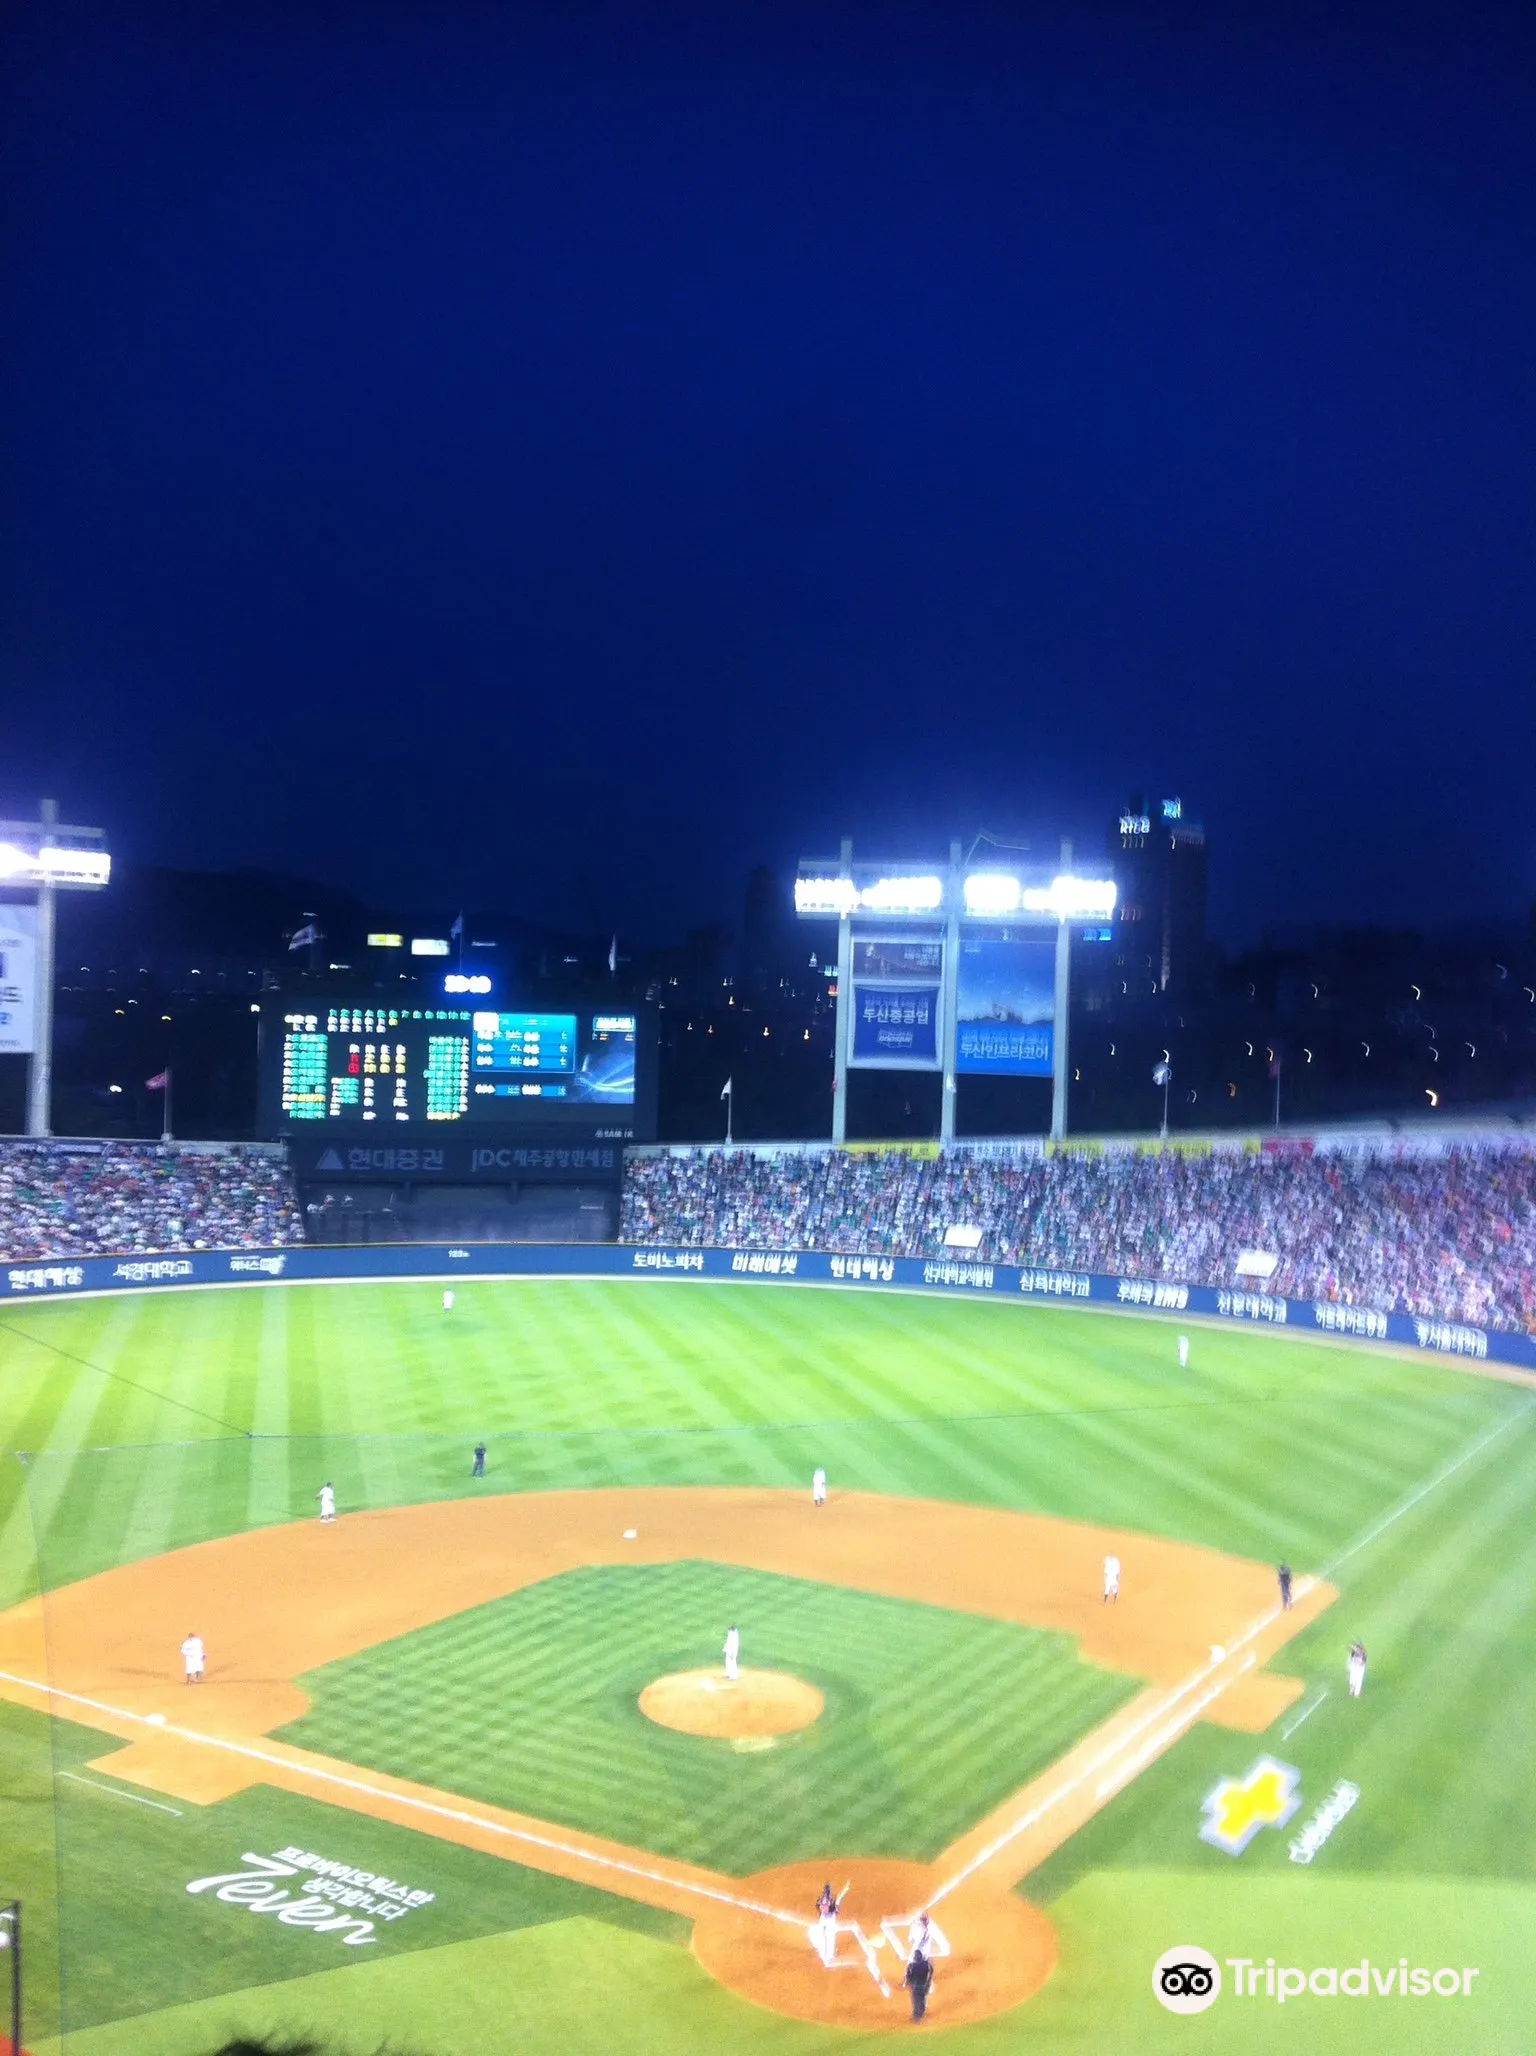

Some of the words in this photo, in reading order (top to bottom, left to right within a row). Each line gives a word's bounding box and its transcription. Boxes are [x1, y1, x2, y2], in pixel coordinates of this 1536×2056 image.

[863, 1009, 929, 1025] 두산중공업
[959, 1041, 1049, 1061] 두산인프라코어
[348, 1148, 444, 1172] 현대증권
[472, 1150, 511, 1172] JDC
[632, 1251, 704, 1271] 도미노피자
[731, 1252, 798, 1275] 미래에셋
